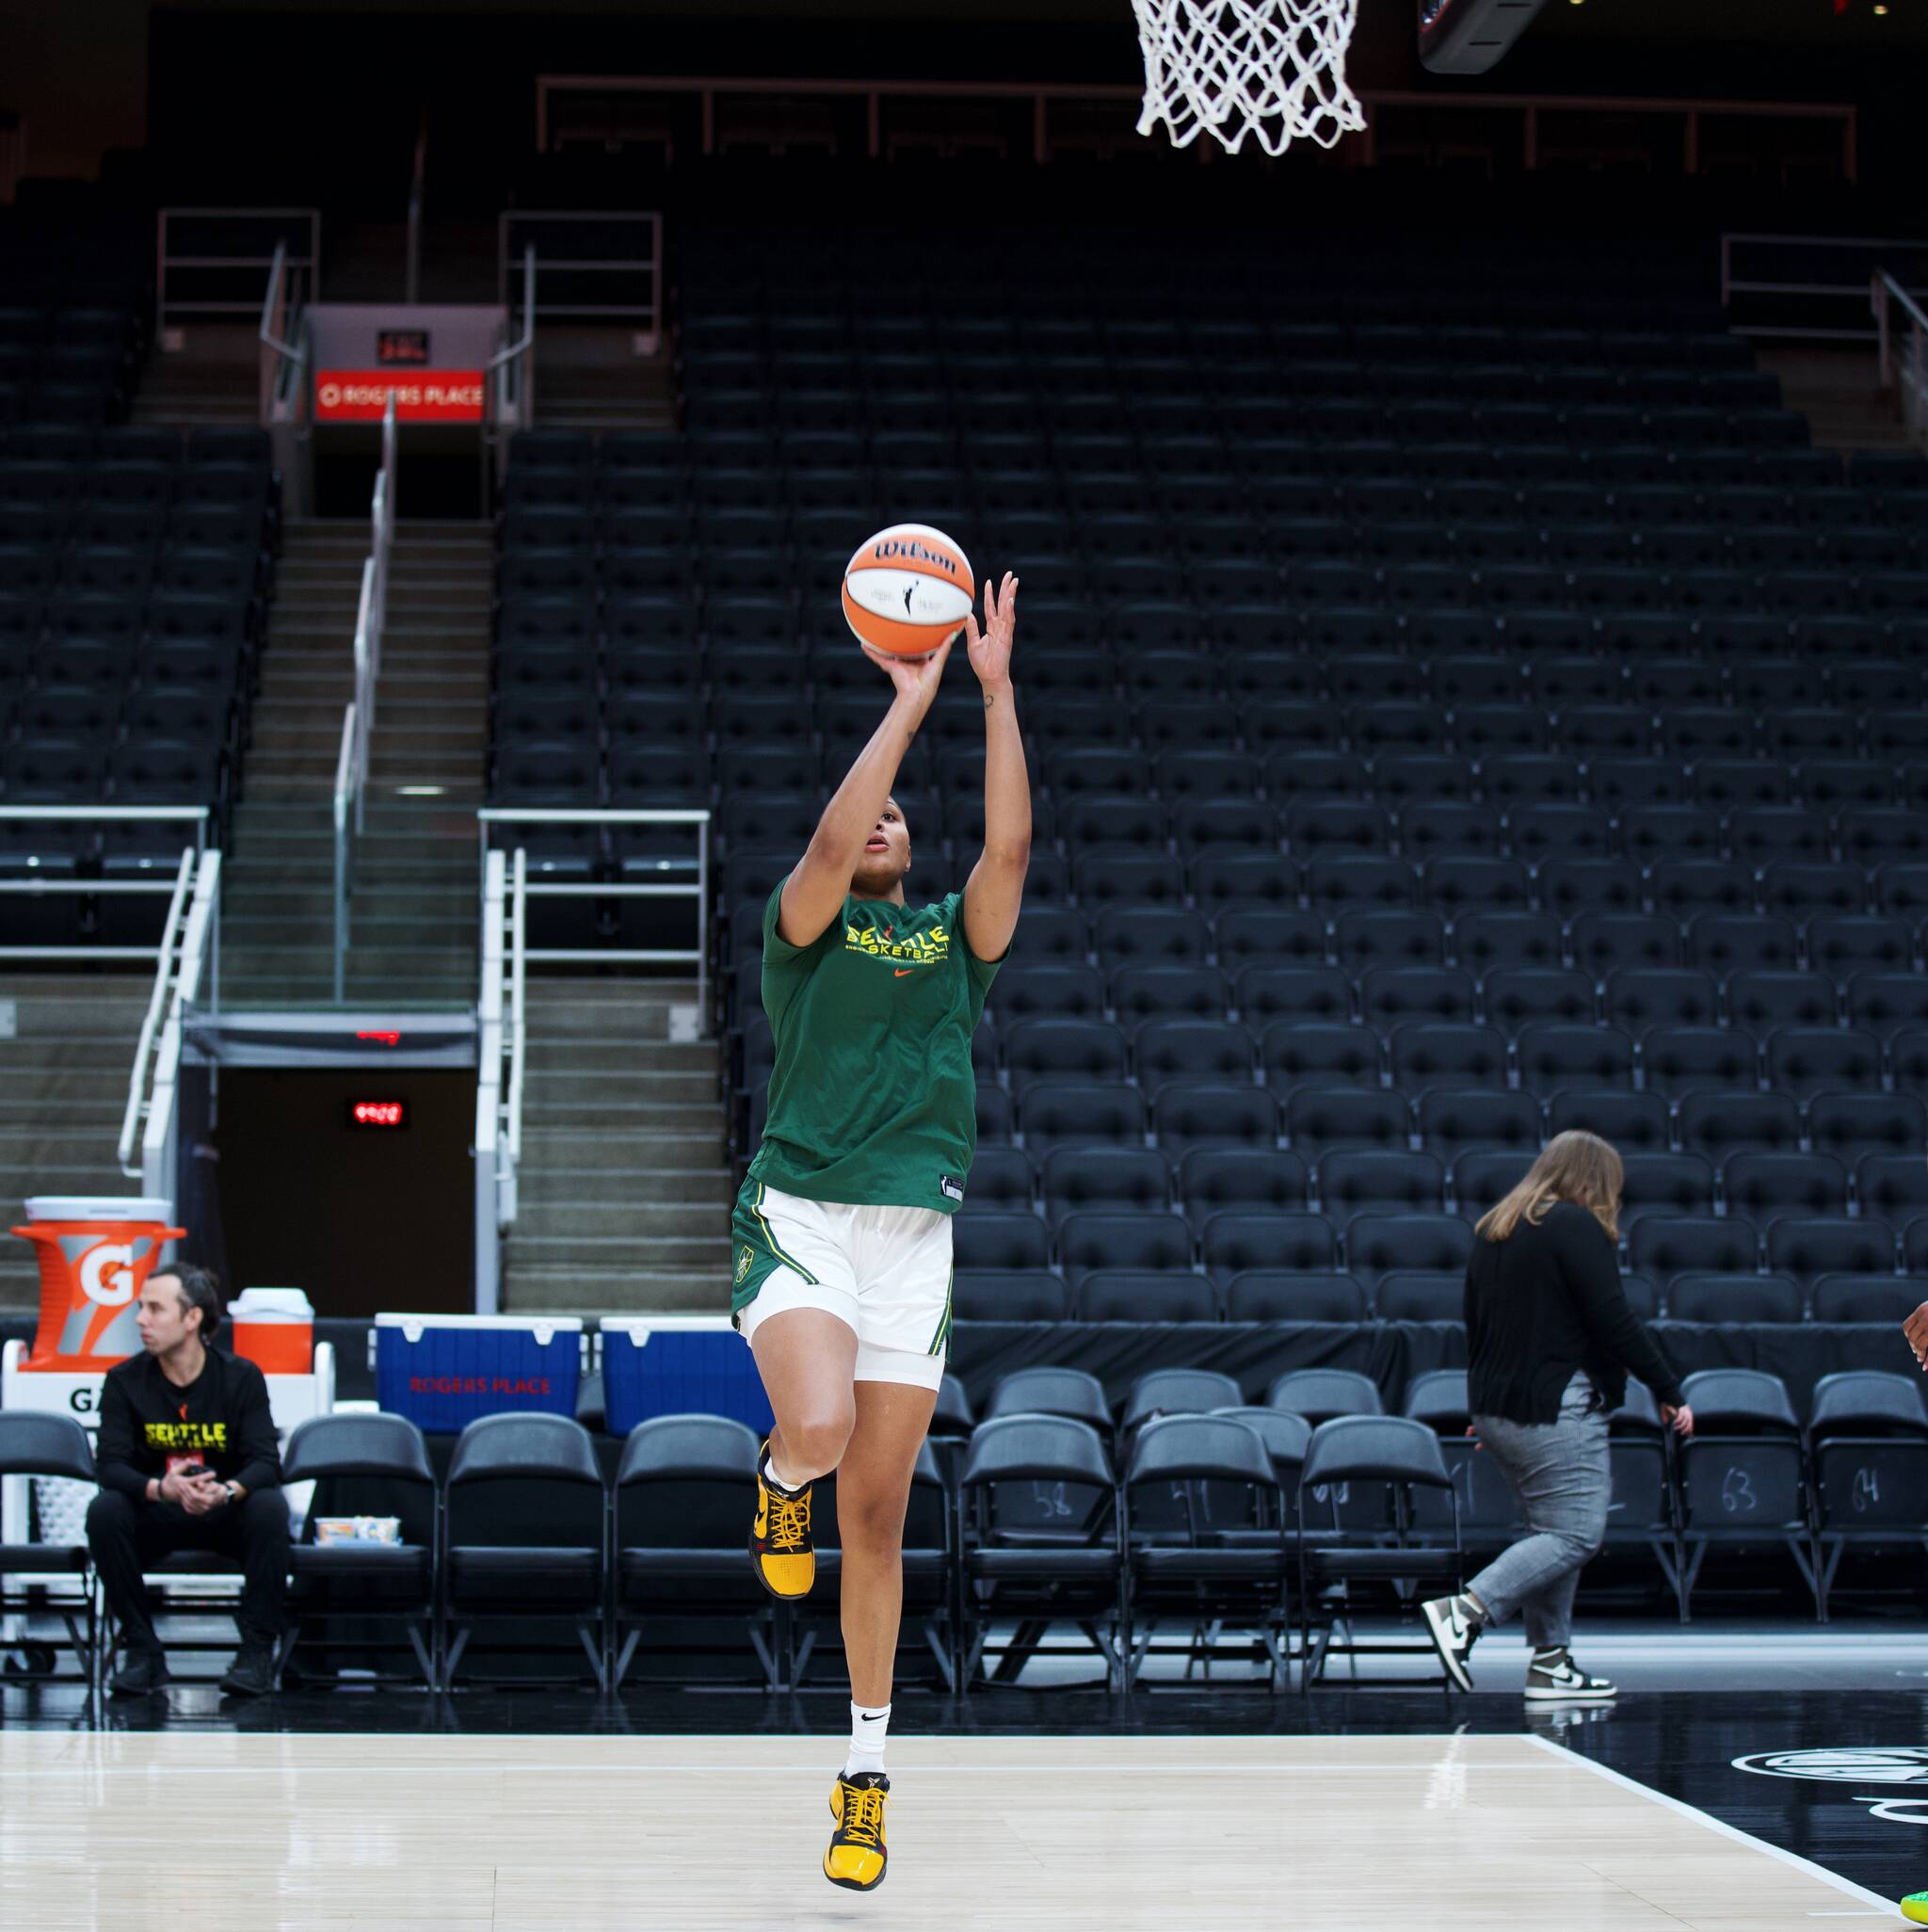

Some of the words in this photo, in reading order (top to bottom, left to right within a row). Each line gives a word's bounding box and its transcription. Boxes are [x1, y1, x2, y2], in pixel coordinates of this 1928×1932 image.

[343, 386, 421, 406] ROGRS
[875, 541, 956, 575] Wilson
[80, 1245, 134, 1306] G
[410, 1376, 488, 1393] ROGERS
[492, 1377, 551, 1394] PLACE
[1722, 1466, 1758, 1513] 63
[1852, 1467, 1880, 1514] 64
